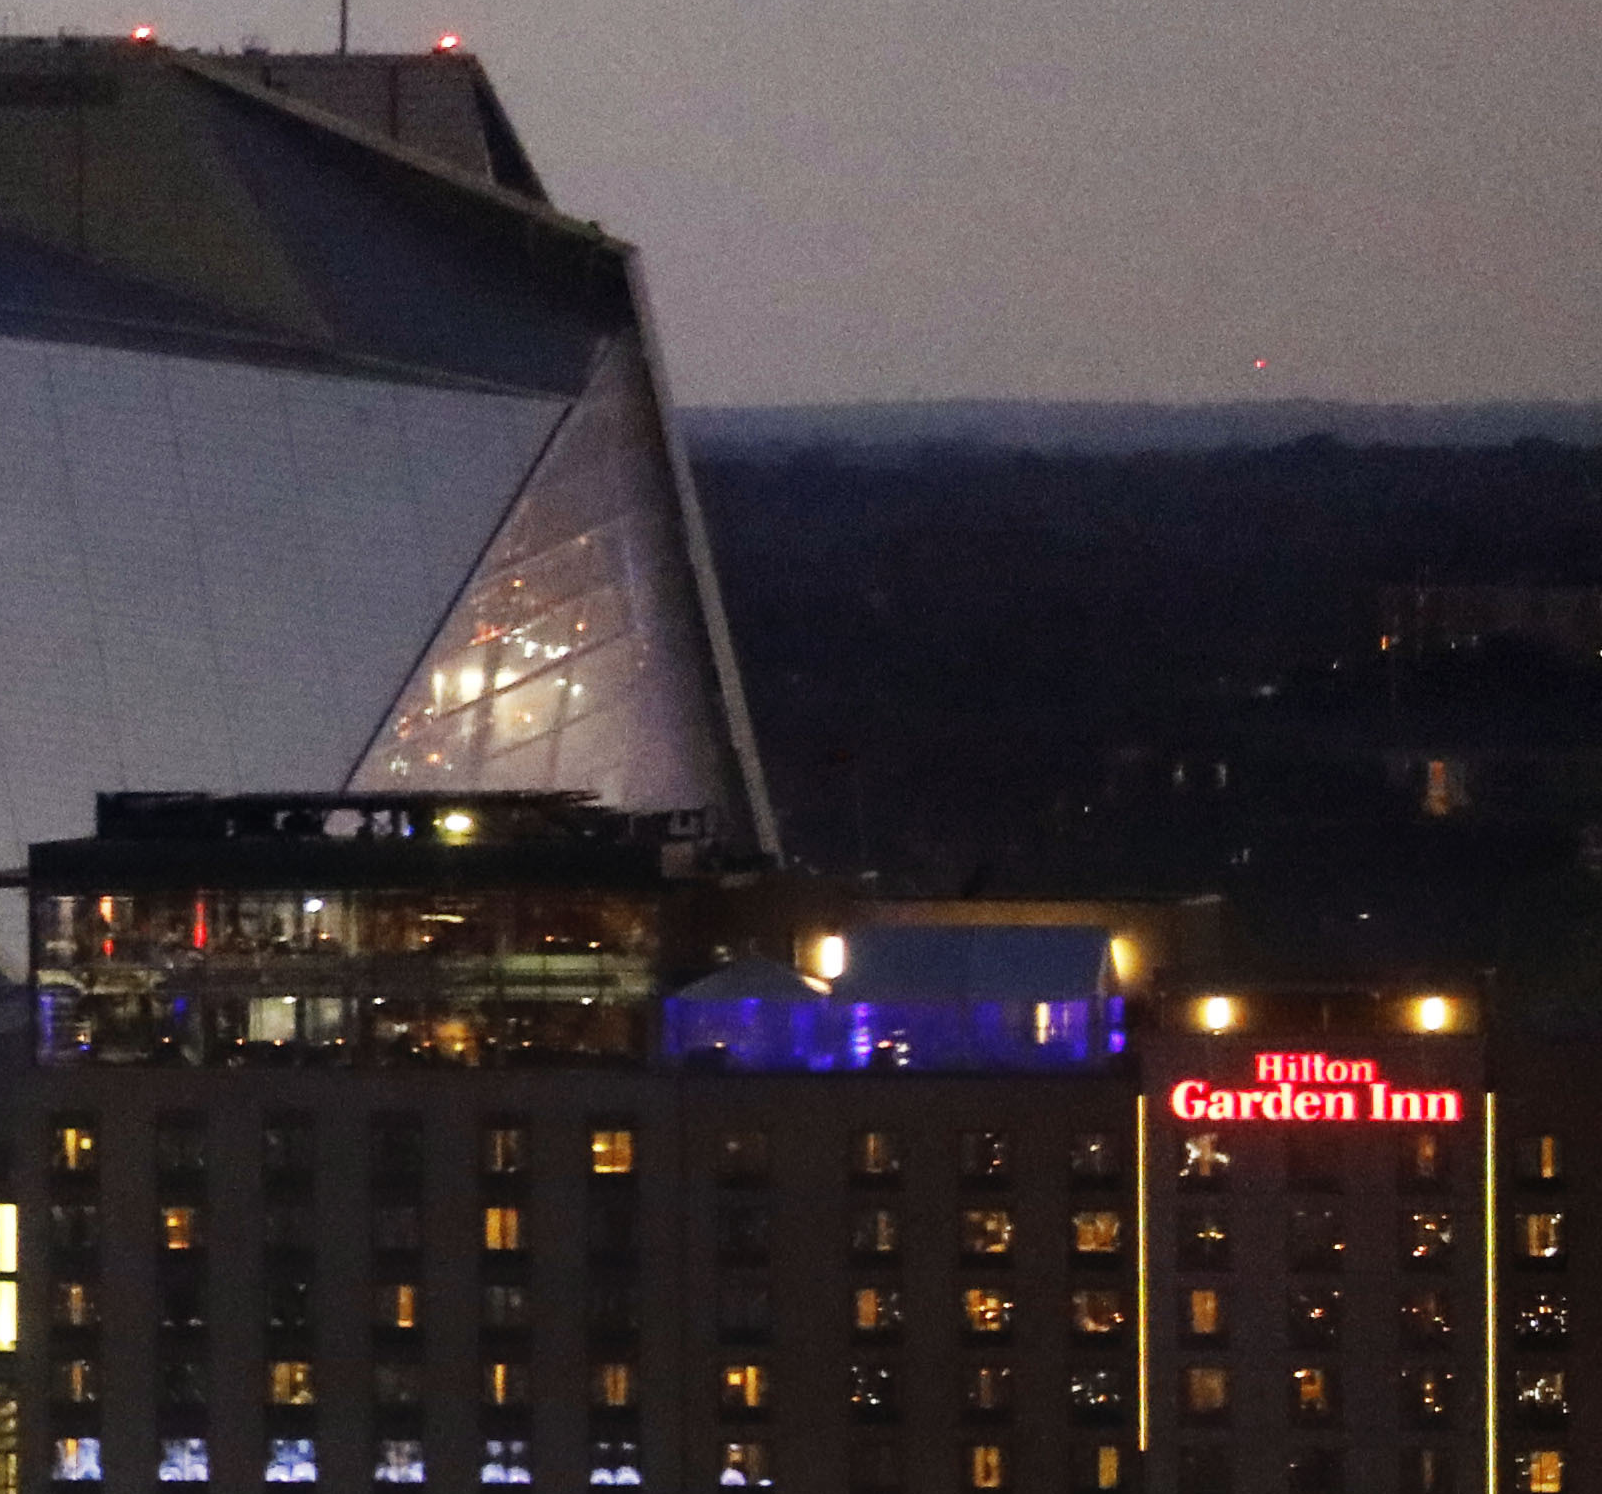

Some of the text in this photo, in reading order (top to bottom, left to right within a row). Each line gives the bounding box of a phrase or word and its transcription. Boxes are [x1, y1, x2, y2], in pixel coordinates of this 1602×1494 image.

[1254, 1052, 1379, 1083] Hilton
[1170, 1079, 1462, 1122] Garden Inn
